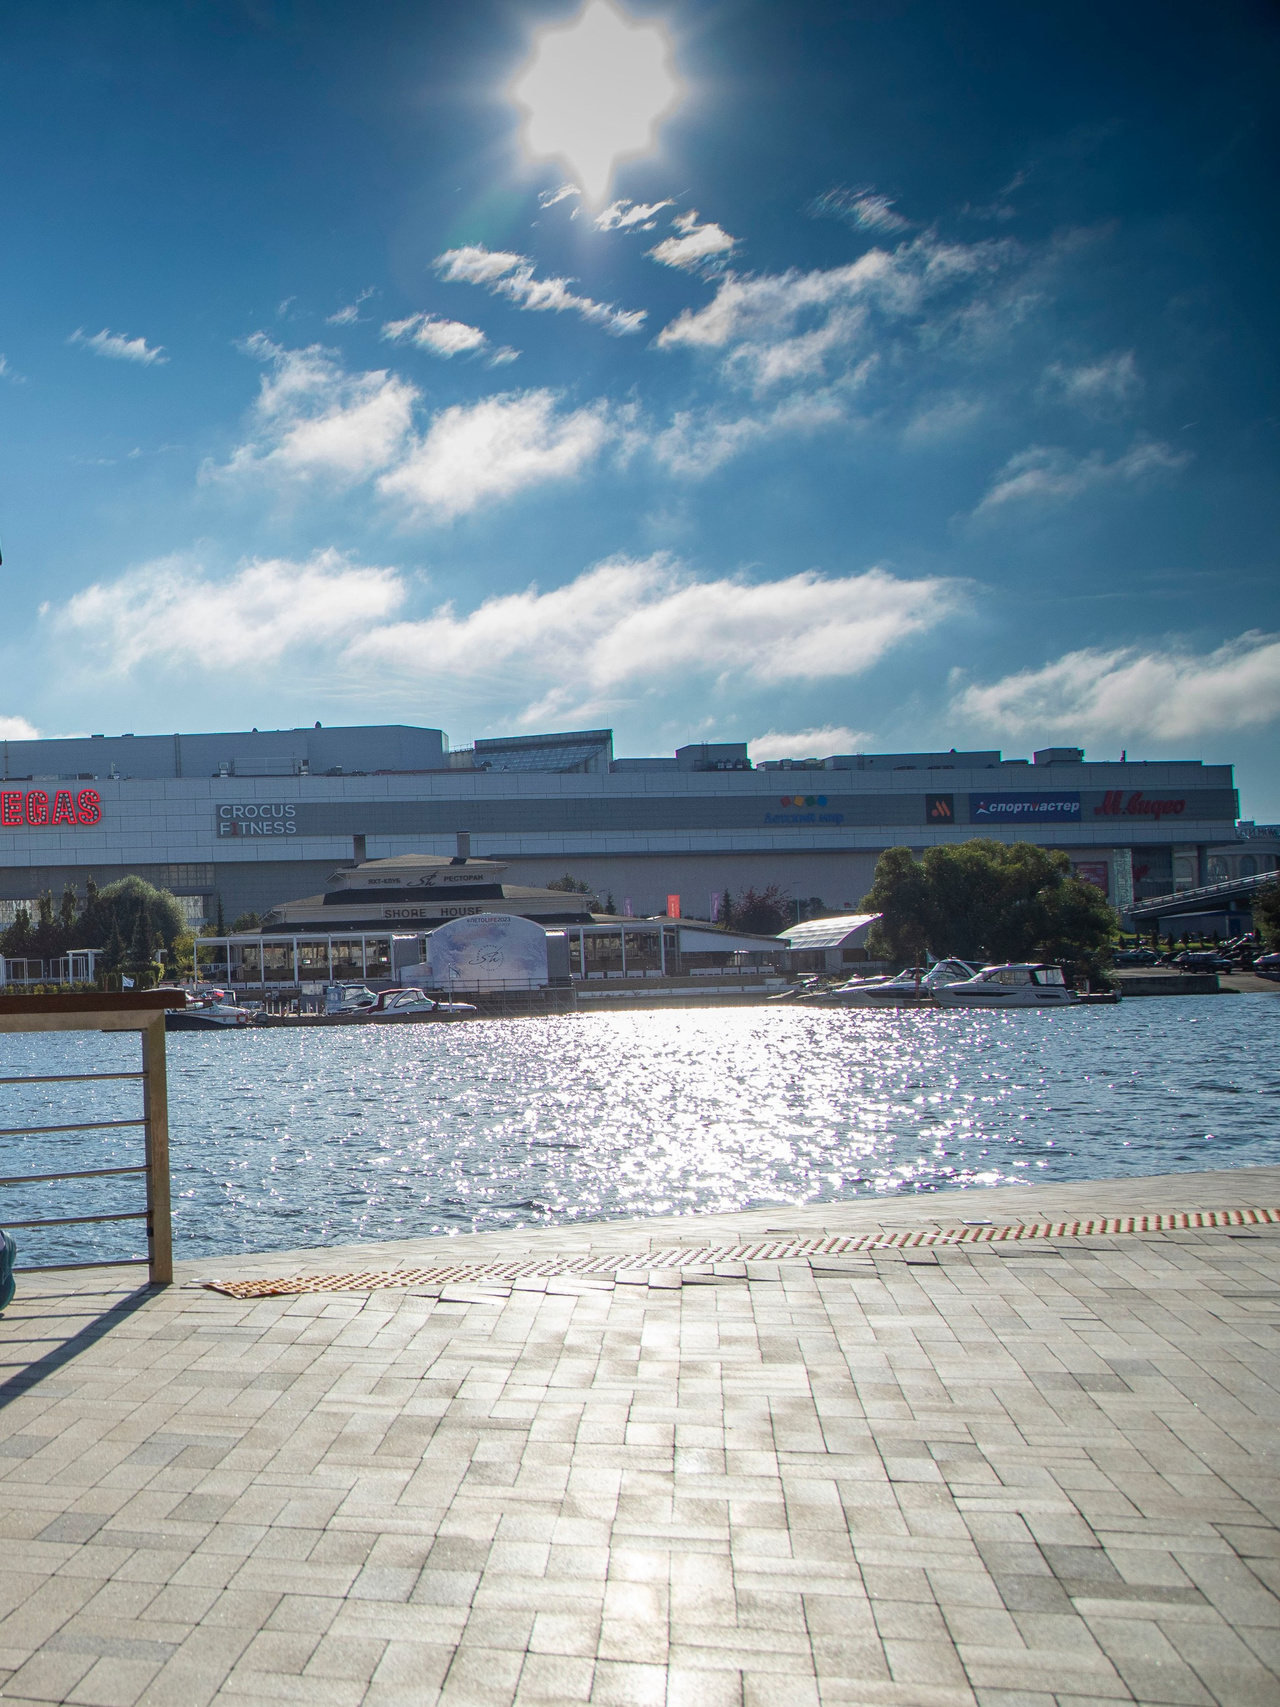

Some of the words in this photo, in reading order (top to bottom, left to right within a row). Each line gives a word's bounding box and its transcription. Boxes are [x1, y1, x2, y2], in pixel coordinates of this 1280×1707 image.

[220, 804, 296, 818] CROCUS
[988, 801, 1080, 814] спортмастер
[443, 874, 484, 882] РЕСТОРАН
[384, 908, 427, 918] SHORE
[440, 906, 483, 916] HOUSE
